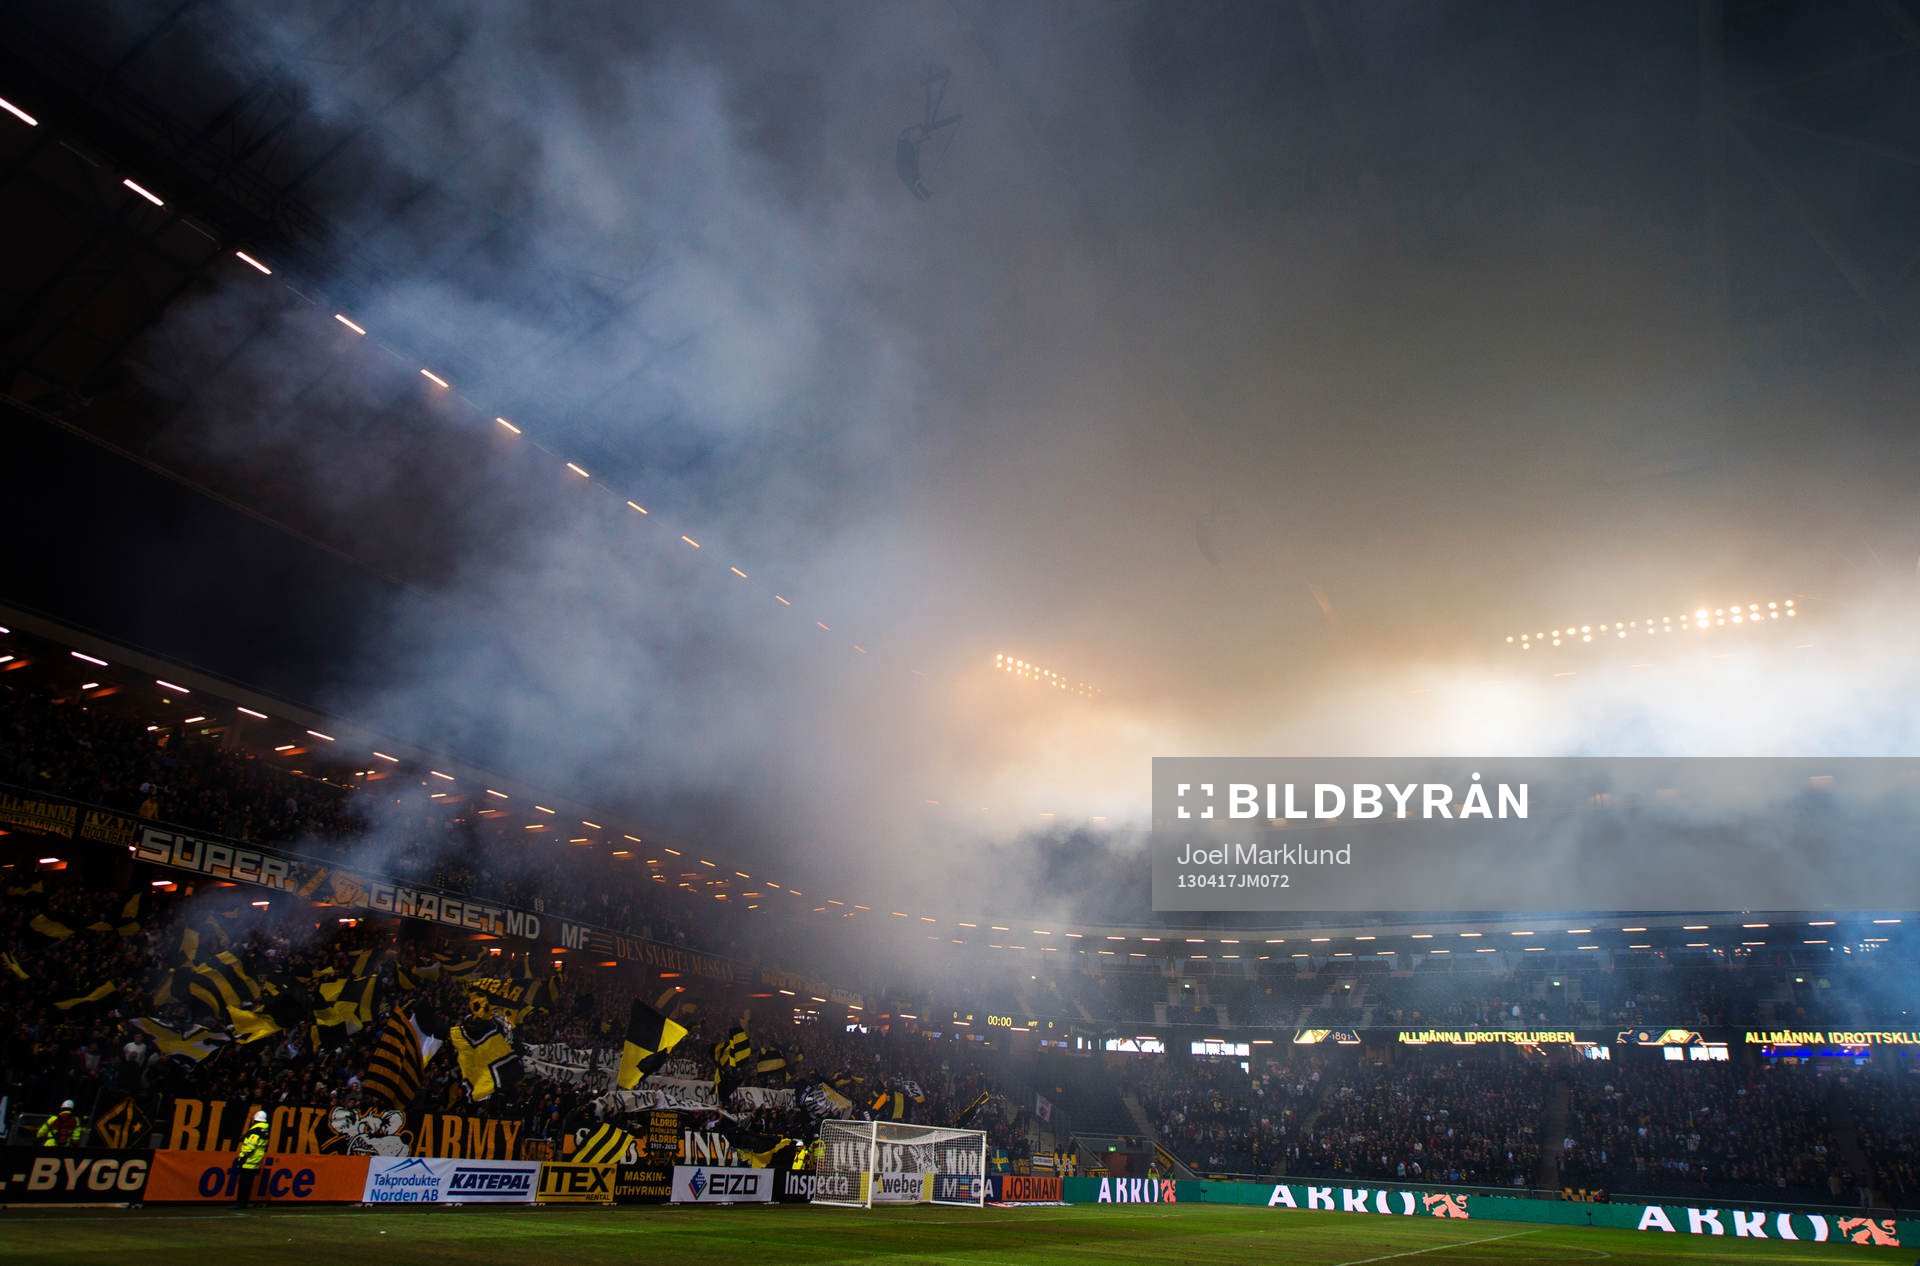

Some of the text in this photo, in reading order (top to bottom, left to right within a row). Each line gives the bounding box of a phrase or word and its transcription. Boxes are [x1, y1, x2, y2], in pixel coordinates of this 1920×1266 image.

[137, 826, 291, 888] SUPER
[369, 882, 504, 934] GNAGET
[507, 909, 541, 939] MD
[561, 922, 592, 950] MF
[987, 1015, 1012, 1027] 00:00
[1398, 1030, 1575, 1043] ALLMÄNNA IDROTTSKLUBBEN
[1745, 1030, 1824, 1044] ALLMÄNNA
[650, 1118, 678, 1127] ALDRIG
[415, 1112, 522, 1161] ARMY
[649, 1134, 678, 1144] ALDRIG
[199, 1158, 315, 1198] ofice
[374, 1174, 441, 1188] Takprodukter
[449, 1174, 531, 1190] KATEPAL
[540, 1166, 612, 1193] ITEX
[624, 1170, 667, 1182] MASKIN-
[709, 1174, 758, 1195] EIZO
[785, 1169, 849, 1200] Inspecta
[882, 1173, 923, 1194] weber
[371, 1189, 439, 1201] Norden AB
[615, 1185, 672, 1198] UTHYRNING
[1006, 1178, 1058, 1200] JOBMAN
